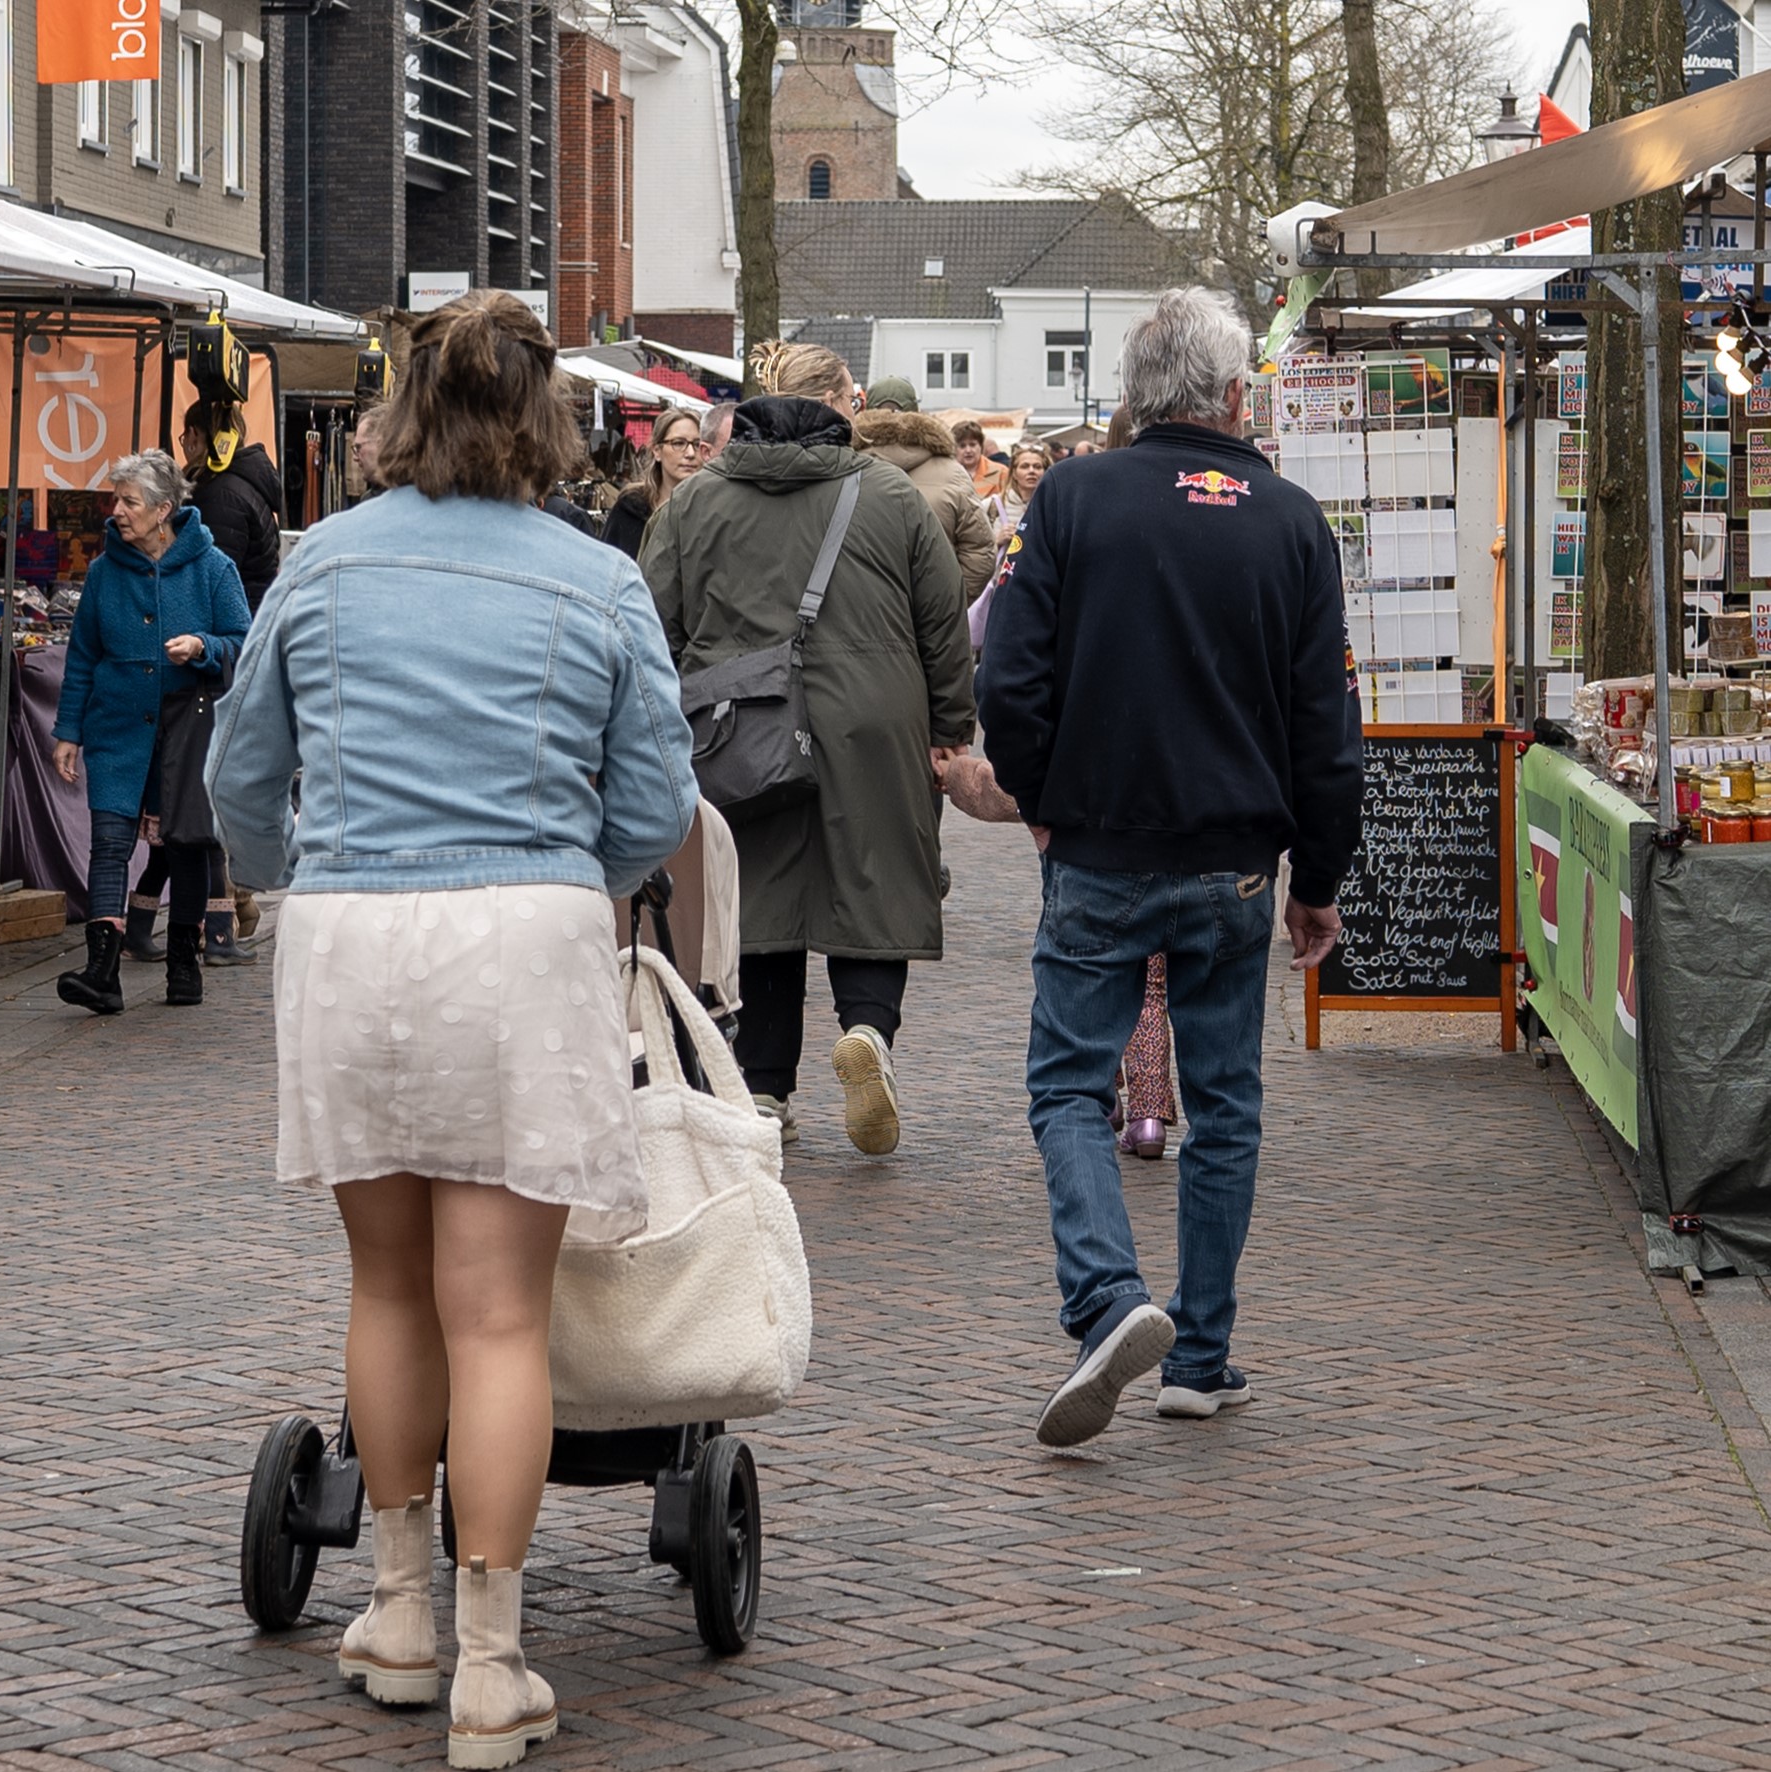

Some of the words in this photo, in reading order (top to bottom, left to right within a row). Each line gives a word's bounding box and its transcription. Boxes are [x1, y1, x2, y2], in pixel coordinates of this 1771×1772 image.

[413, 288, 465, 296] INTERSPORT
[1557, 545, 1568, 554] IK
[1757, 617, 1768, 626] IS
